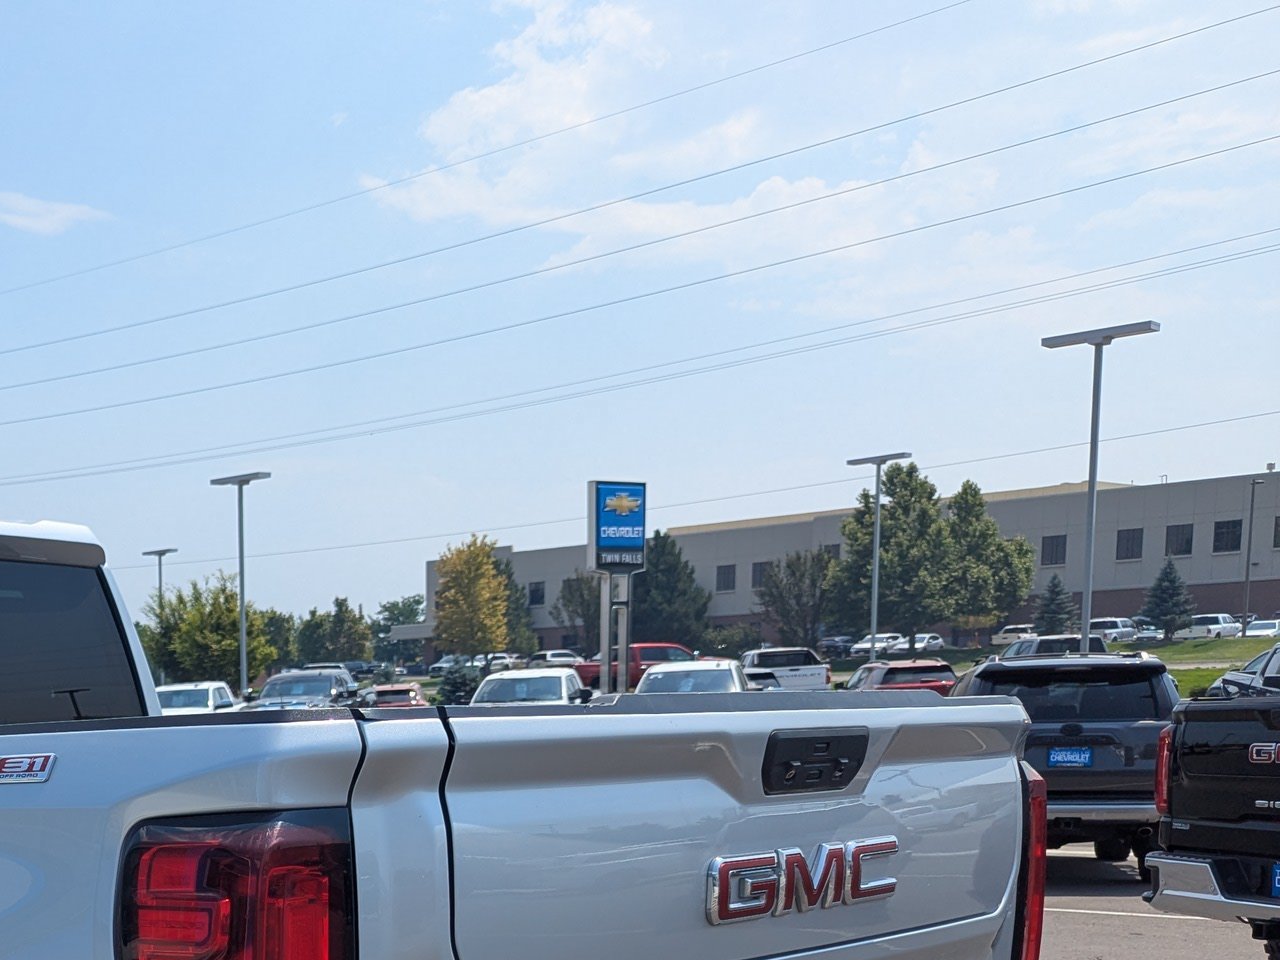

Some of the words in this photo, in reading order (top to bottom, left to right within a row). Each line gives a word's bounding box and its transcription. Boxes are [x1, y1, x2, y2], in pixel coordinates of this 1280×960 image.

[601, 527, 643, 538] CHEVROLET
[602, 553, 619, 563] TWIN
[621, 552, 642, 563] FALLS
[1050, 754, 1089, 763] CHEVROLET
[706, 835, 898, 926] GMC
